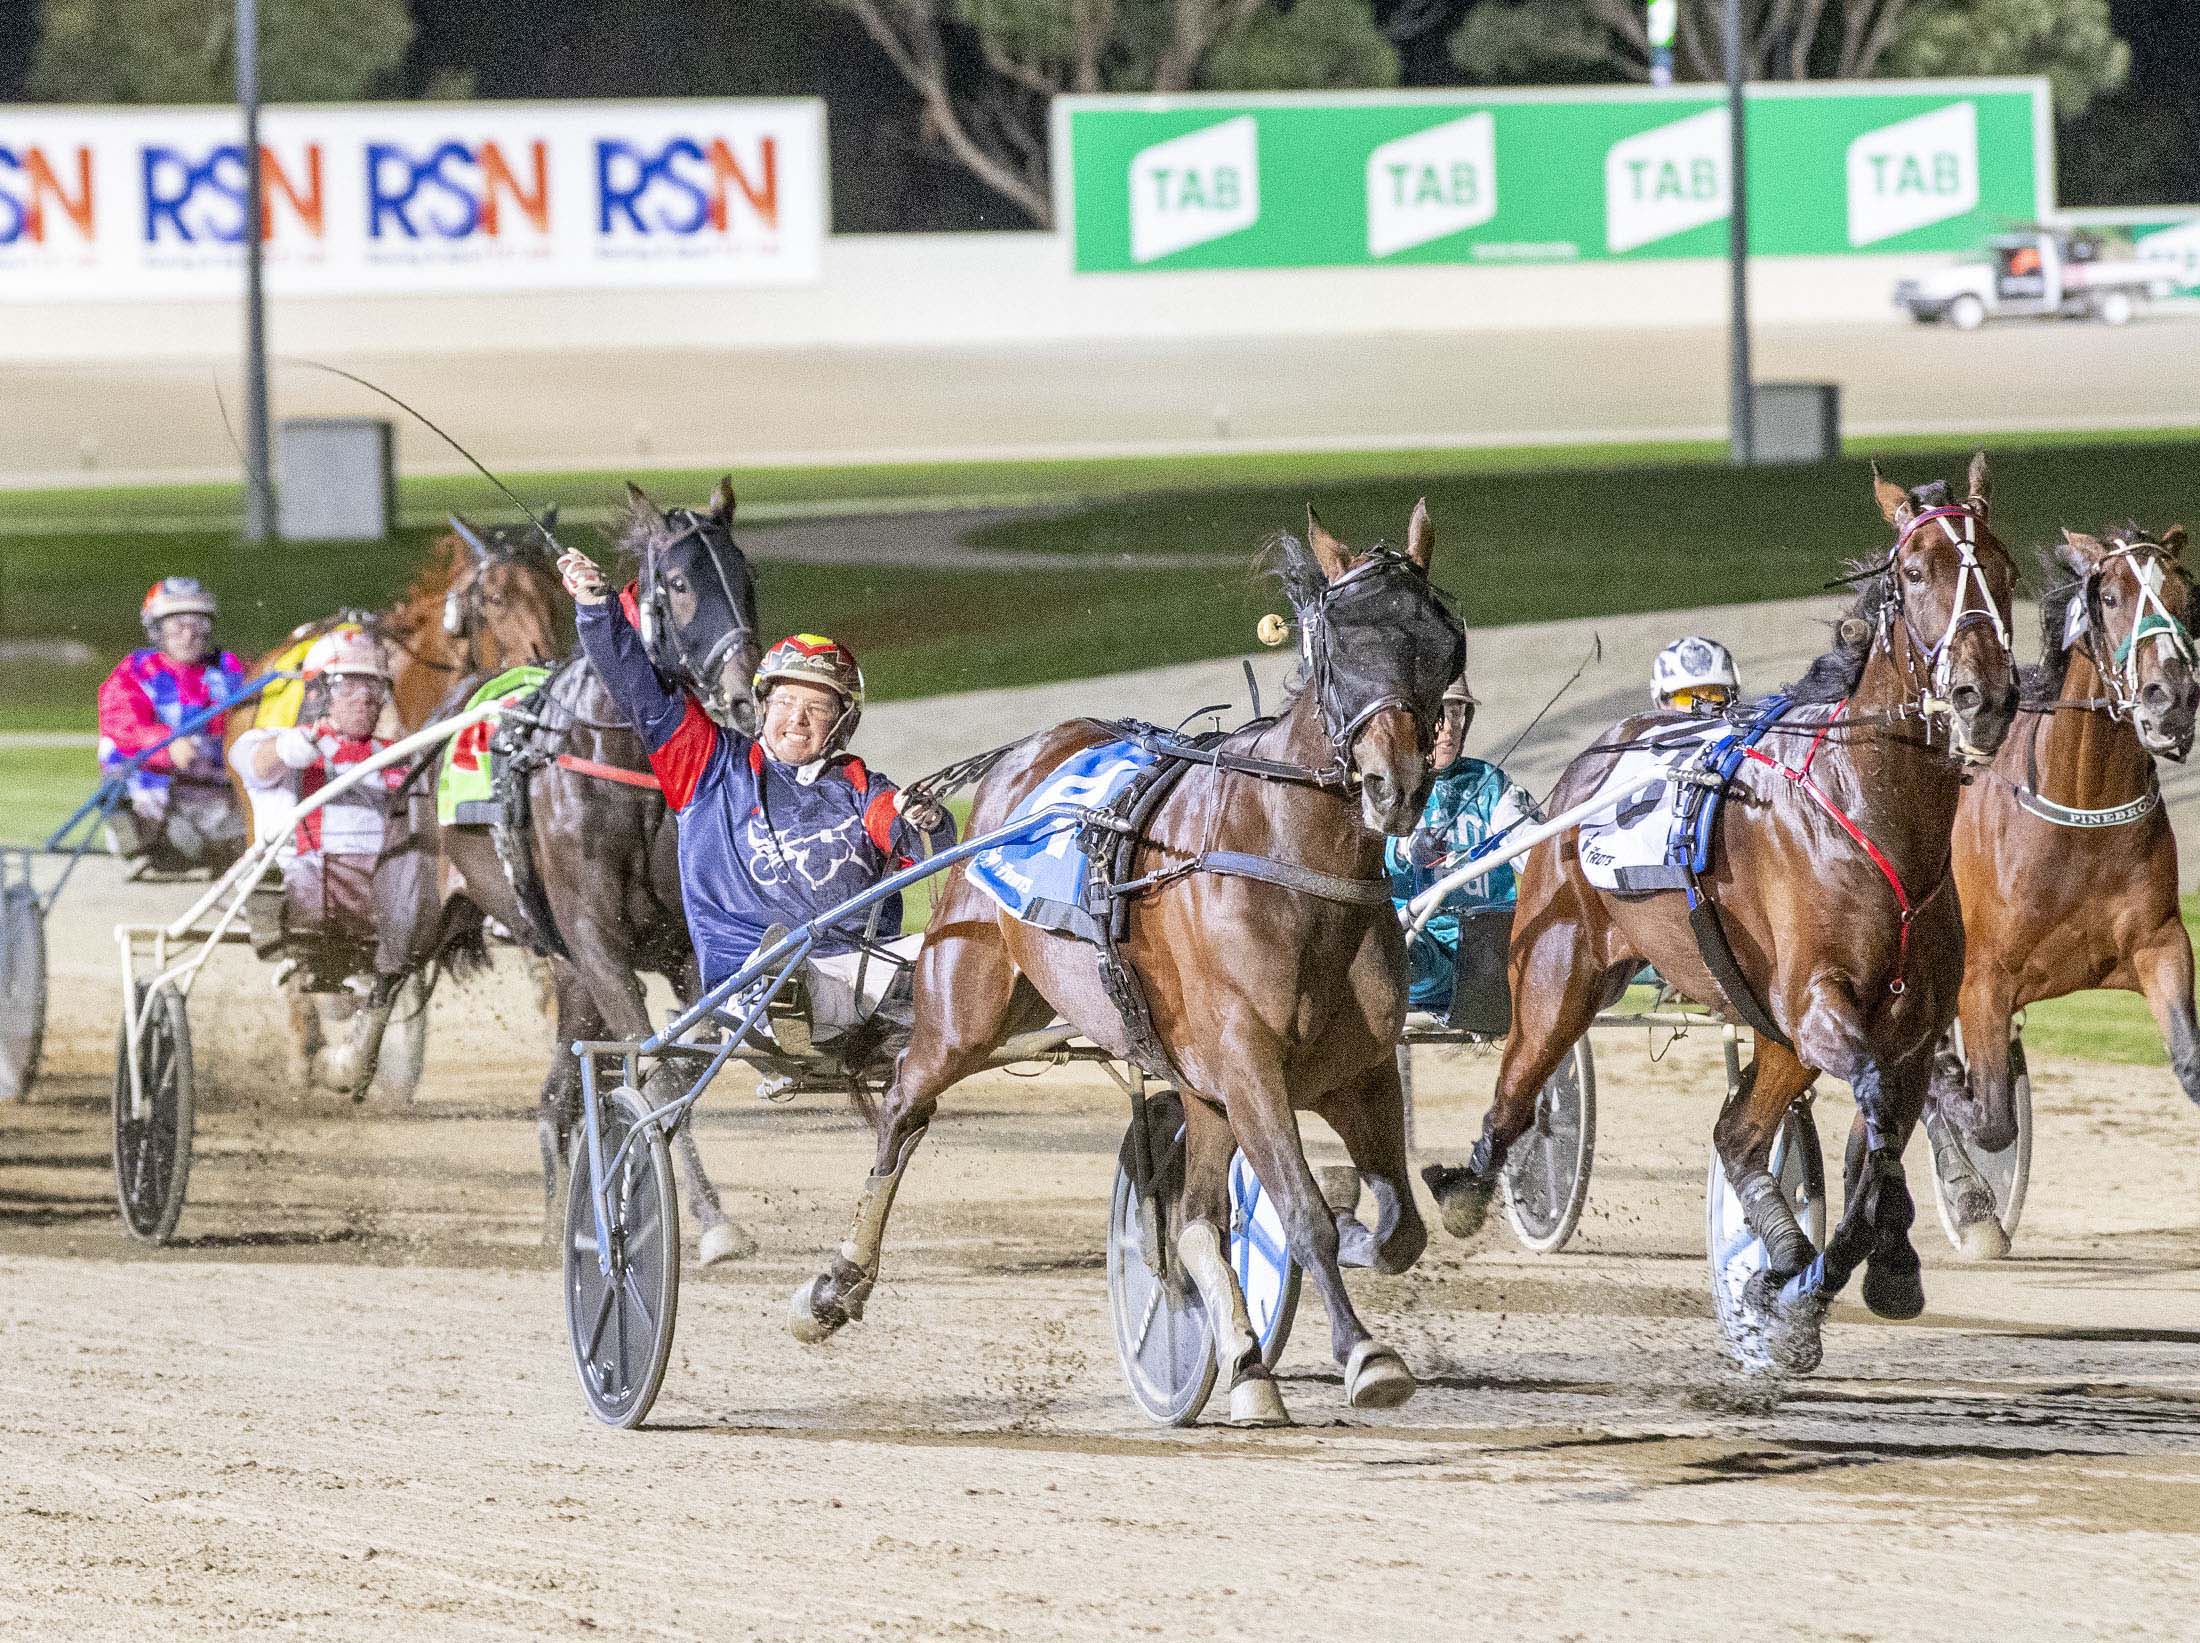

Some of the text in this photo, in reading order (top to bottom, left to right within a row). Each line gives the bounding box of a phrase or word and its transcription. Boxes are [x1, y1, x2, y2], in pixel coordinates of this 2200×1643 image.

[0, 143, 95, 243] SN
[139, 143, 323, 242] RSN
[364, 140, 549, 239] RSN
[595, 137, 778, 235] RSN
[1151, 166, 1241, 211] TAB
[1387, 161, 1479, 207] TAB
[1624, 157, 1719, 202] TAB
[1867, 151, 1961, 196] TAB
